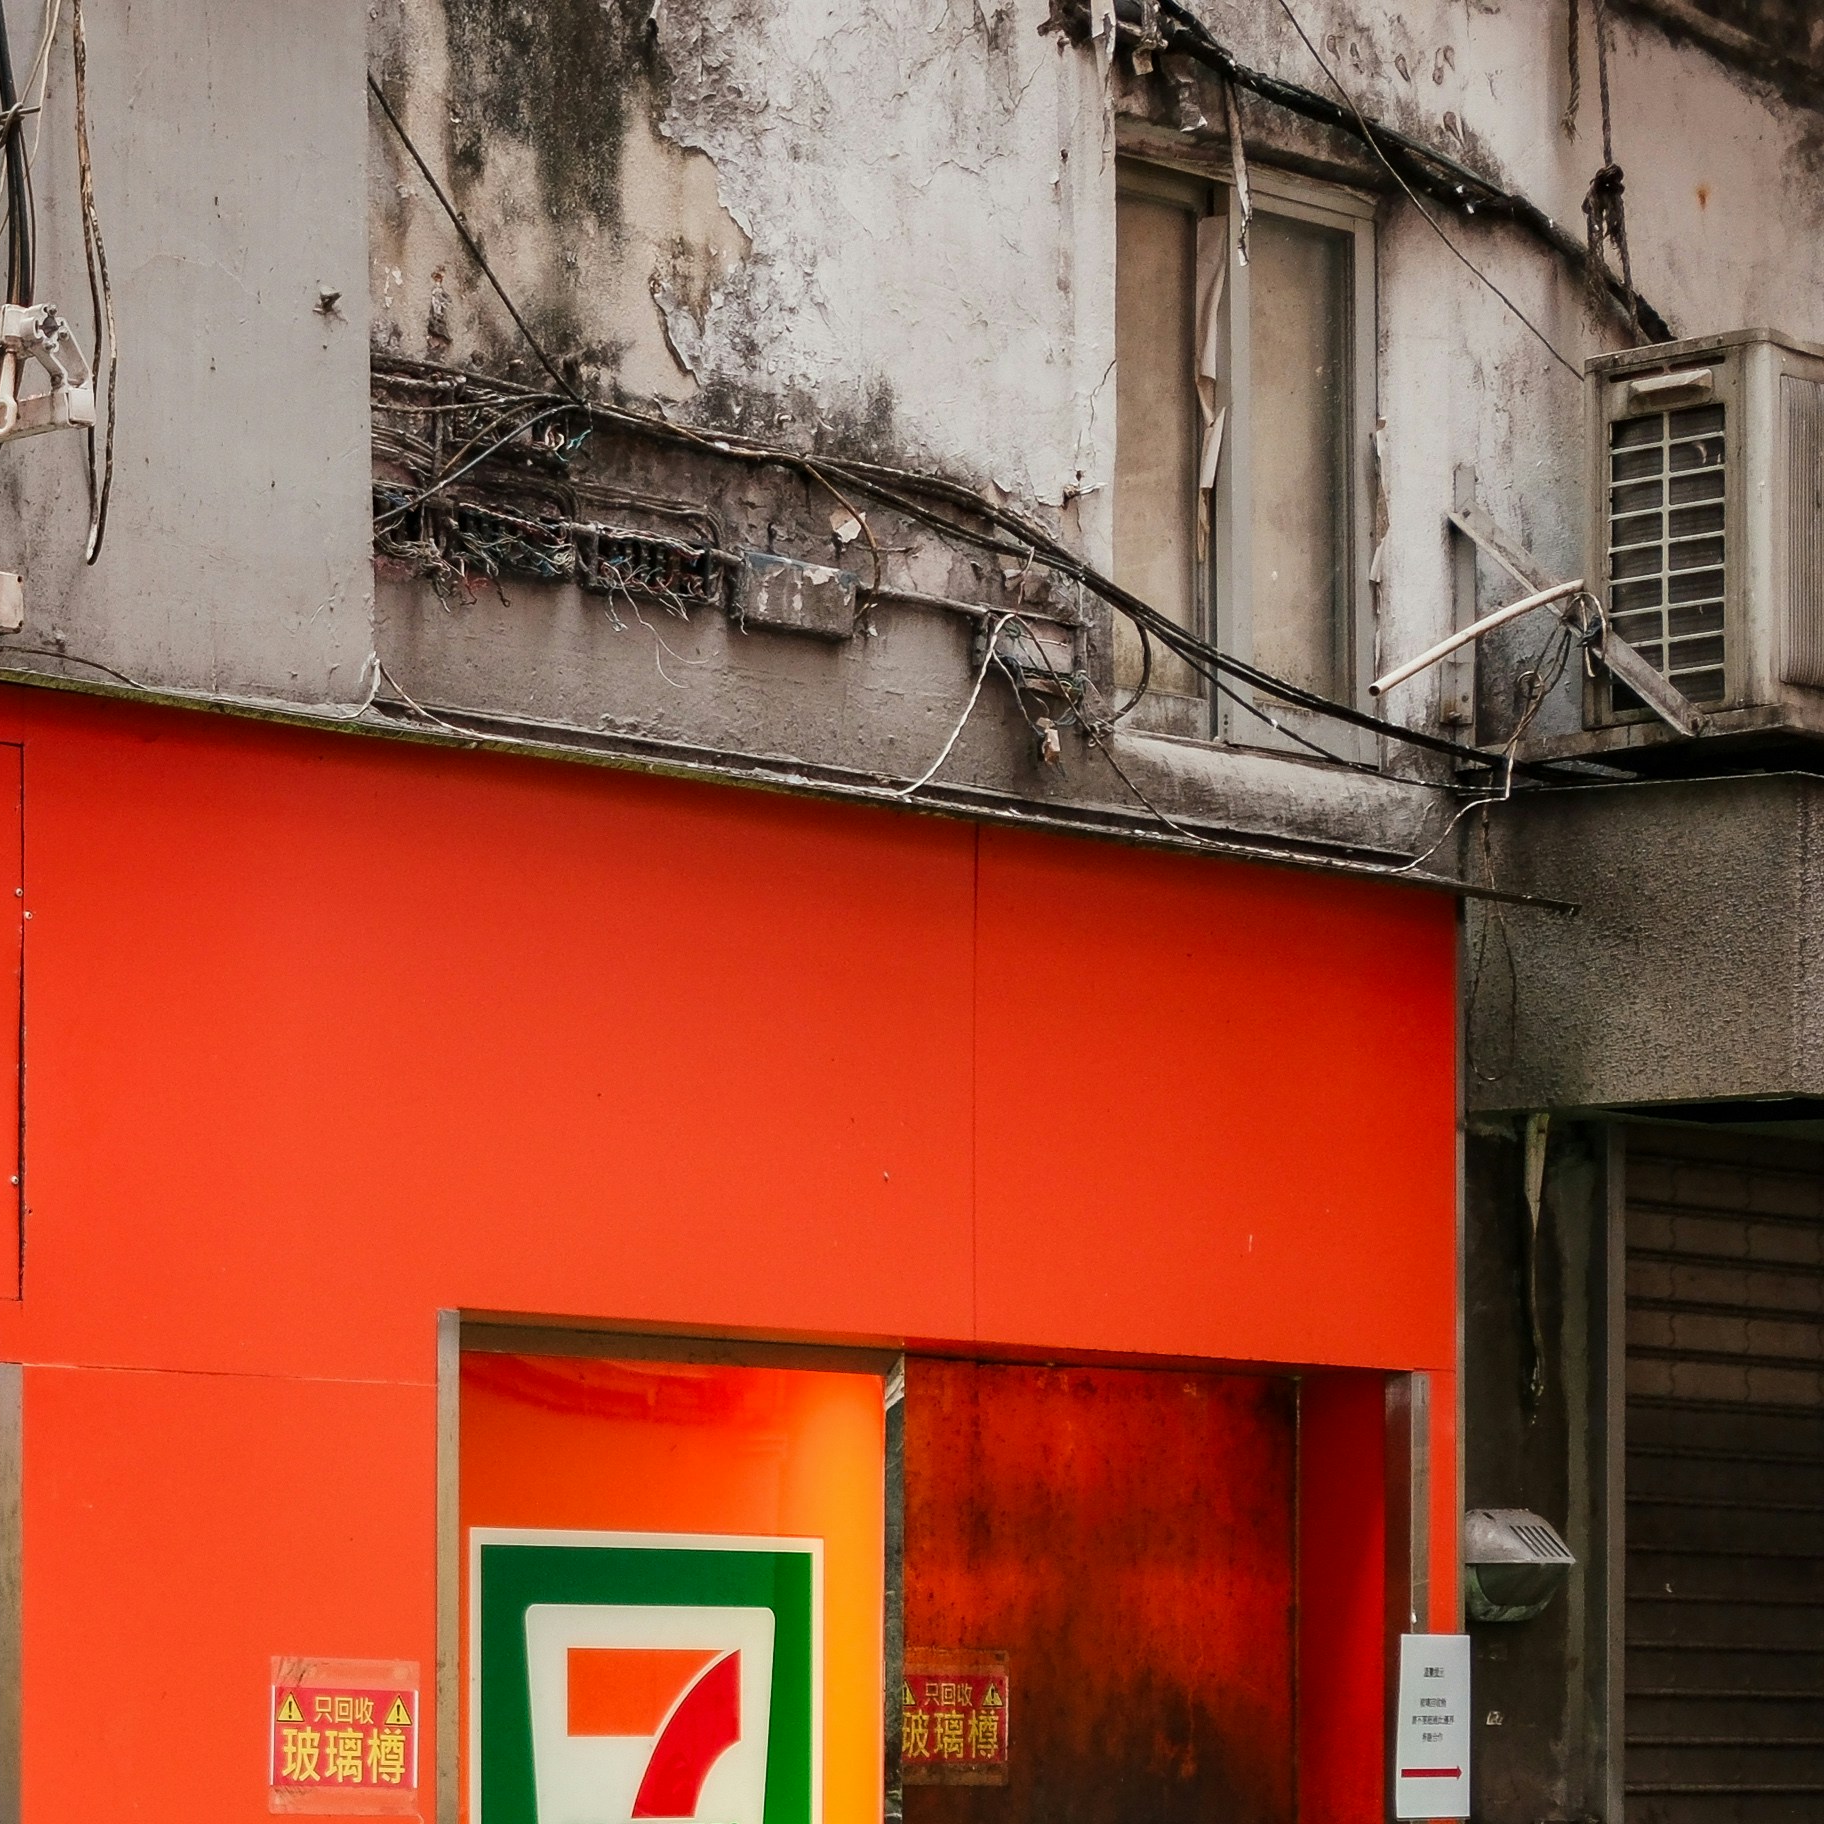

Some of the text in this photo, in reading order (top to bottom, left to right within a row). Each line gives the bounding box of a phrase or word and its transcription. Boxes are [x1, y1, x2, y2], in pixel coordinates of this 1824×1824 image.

[314, 1695, 375, 1724] 只回收
[923, 1682, 974, 1706] 只回收
[901, 1708, 1000, 1759] 玻璃樽
[282, 1726, 407, 1784] 玻璃樽
